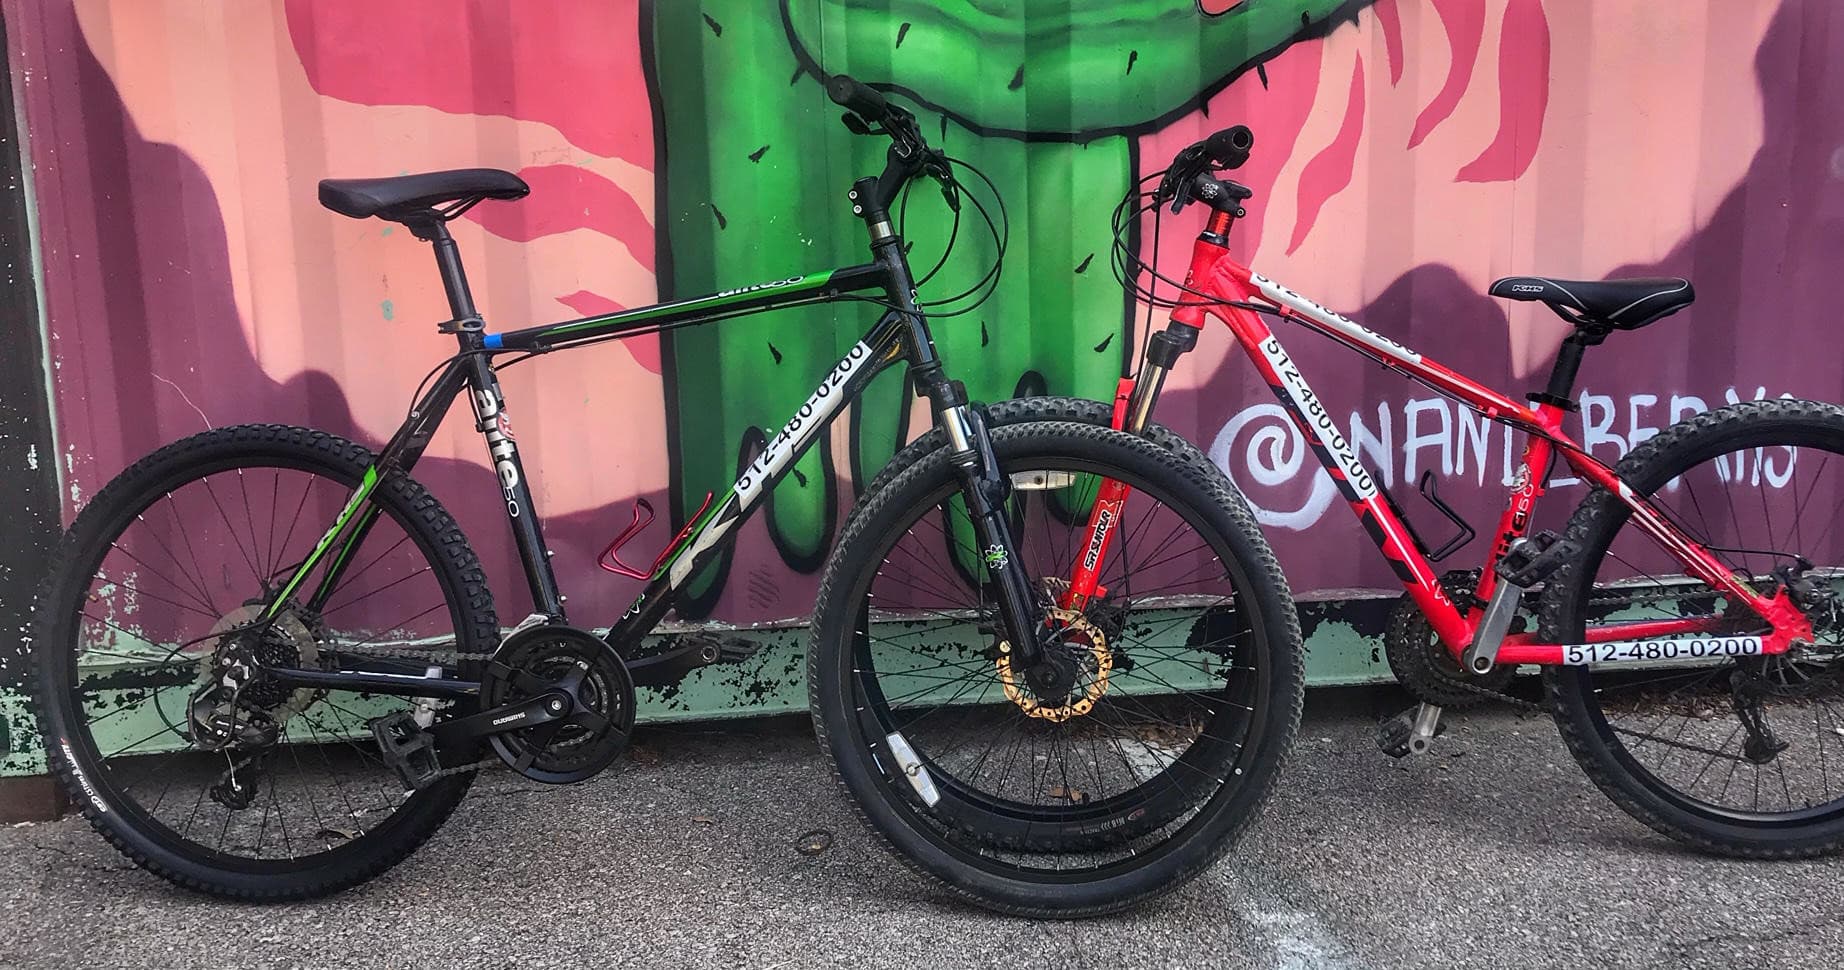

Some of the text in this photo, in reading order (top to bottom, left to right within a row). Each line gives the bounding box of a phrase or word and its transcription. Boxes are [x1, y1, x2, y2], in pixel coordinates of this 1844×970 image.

[737, 344, 864, 491] 512-480-0200
[1267, 340, 1373, 491] 512-480-0200
[1568, 638, 1758, 663] 512-480-0200
